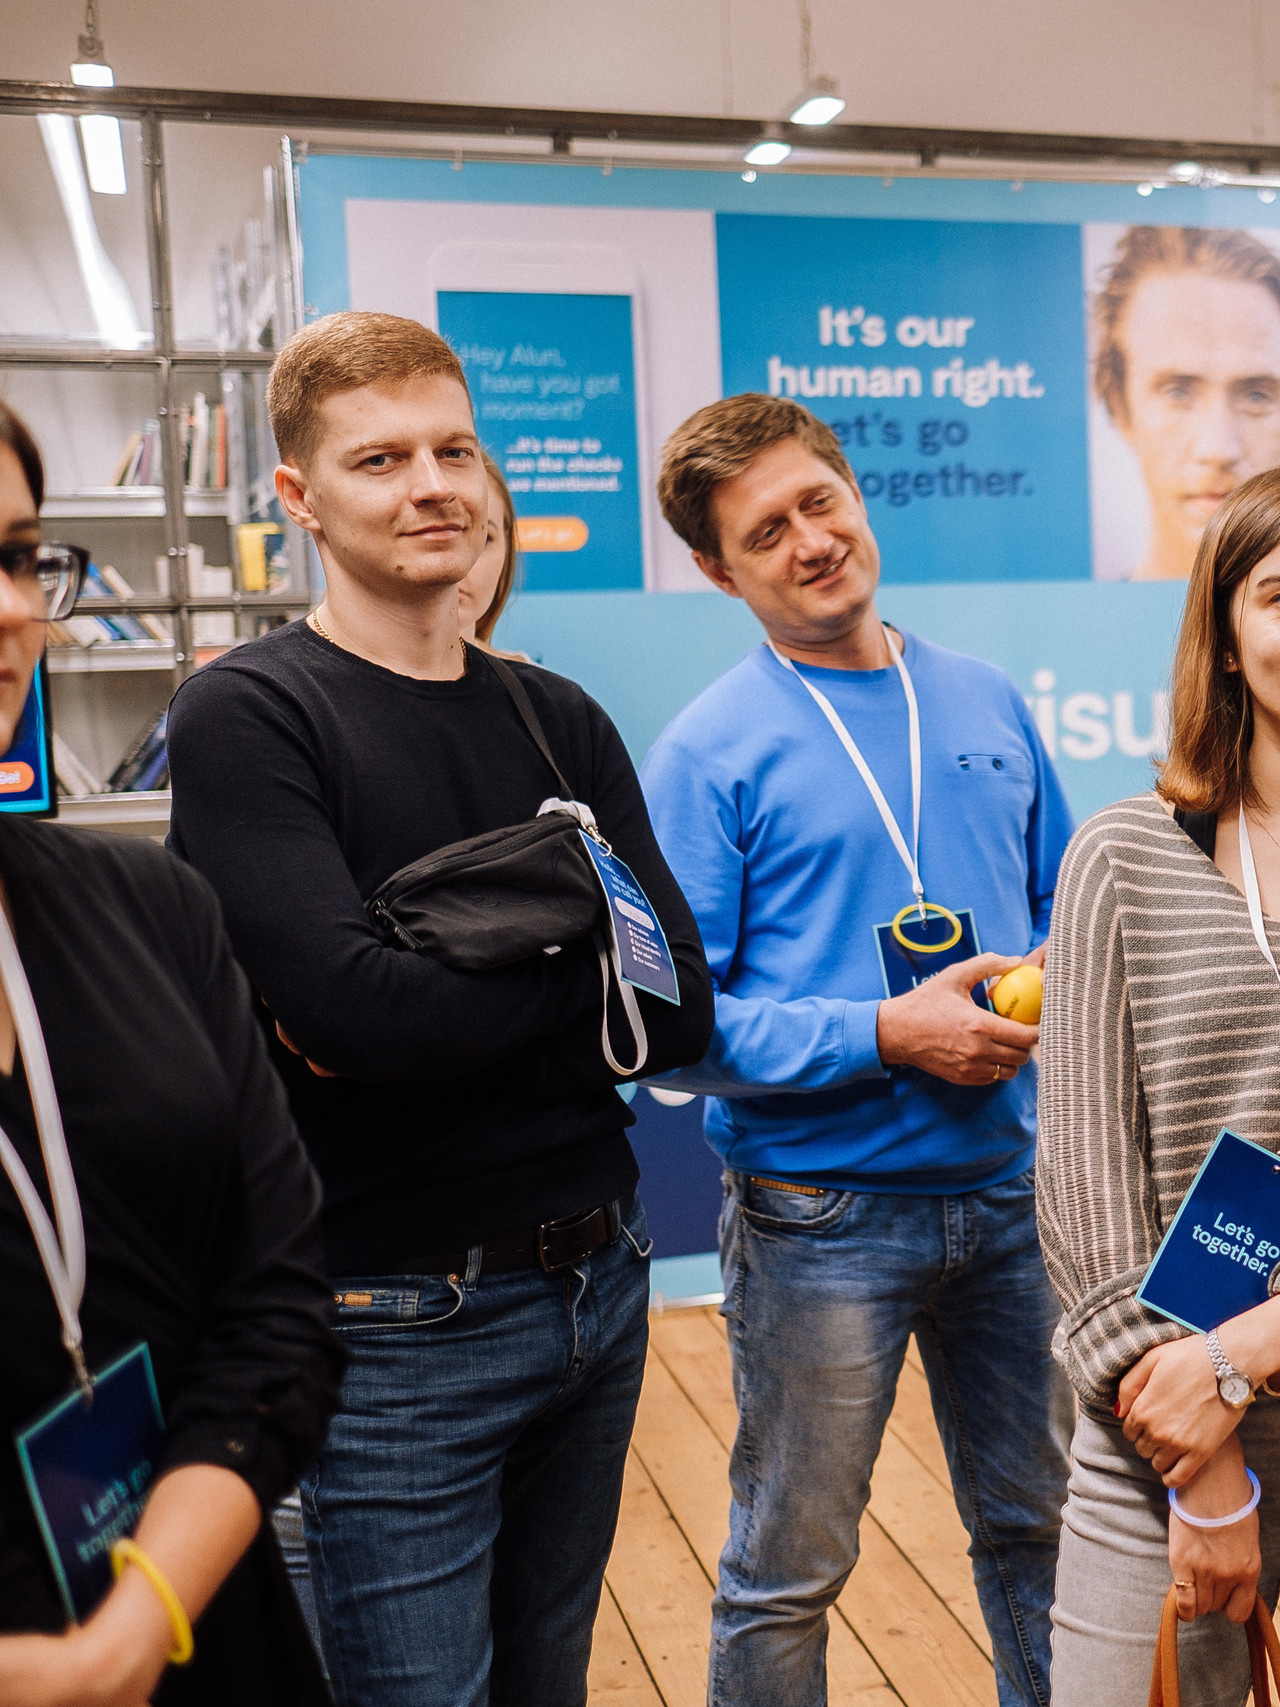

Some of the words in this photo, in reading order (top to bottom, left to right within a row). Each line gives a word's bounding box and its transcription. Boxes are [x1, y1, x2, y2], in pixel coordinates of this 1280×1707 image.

[818, 304, 887, 347] It's
[896, 315, 975, 348] our
[480, 371, 535, 394] have
[538, 374, 581, 399] you
[583, 374, 620, 400] got
[767, 354, 923, 398] human
[931, 356, 1045, 408] right.
[480, 397, 586, 421] moment?
[830, 410, 903, 448] et's
[917, 416, 970, 457] go
[859, 462, 1034, 508] ogether.
[1025, 668, 1173, 761] isu
[1191, 1224, 1269, 1277] together.
[1213, 1212, 1255, 1246] Let's
[1255, 1239, 1280, 1259] go
